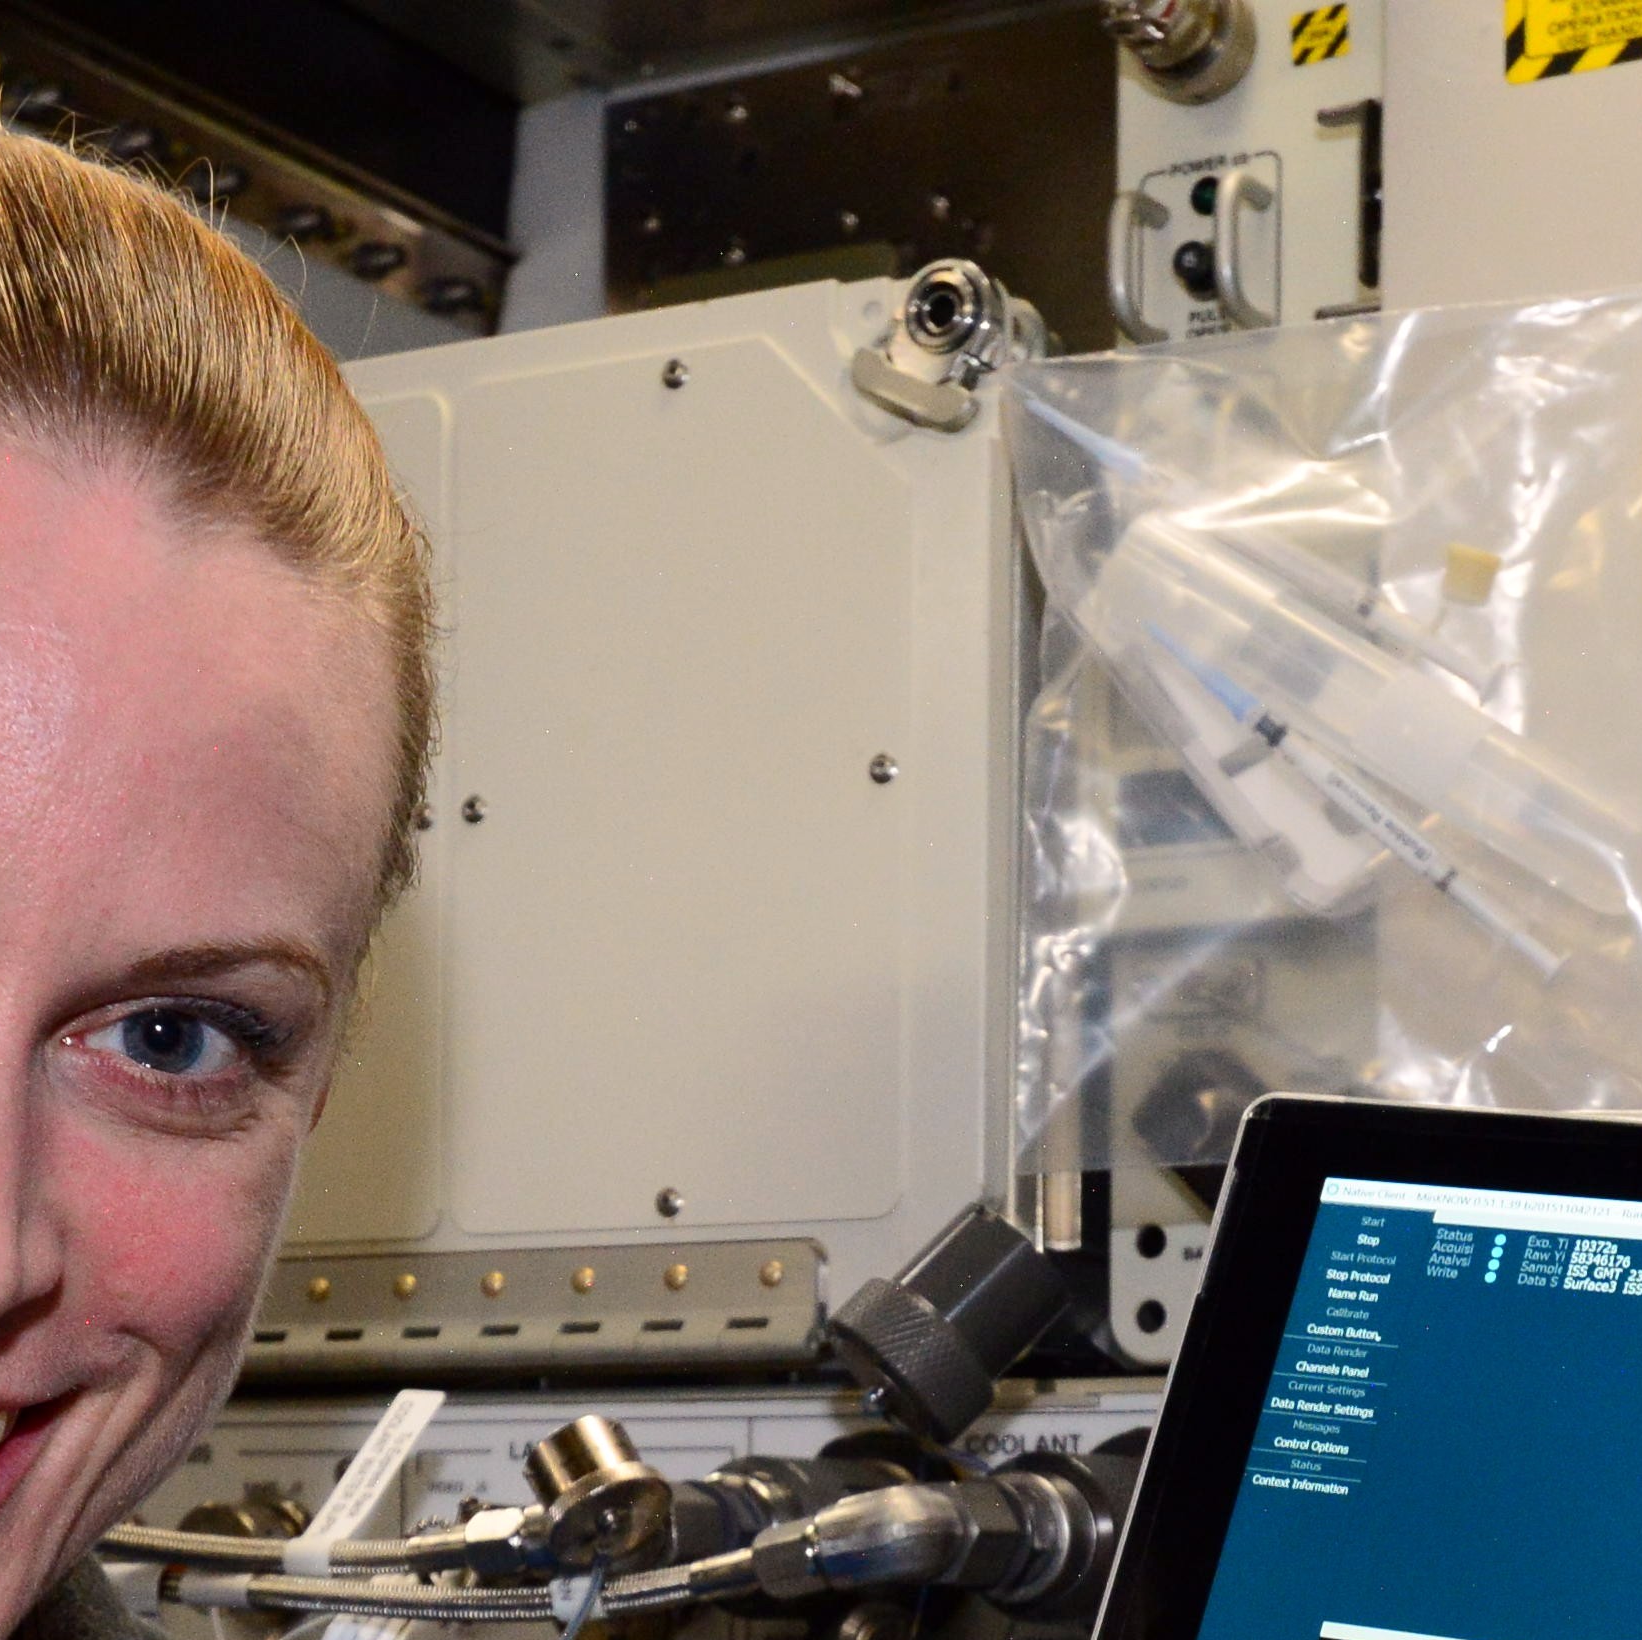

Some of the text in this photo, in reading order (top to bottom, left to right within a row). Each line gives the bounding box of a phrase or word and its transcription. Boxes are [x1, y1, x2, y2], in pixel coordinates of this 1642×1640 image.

[1357, 1233, 1380, 1248] Stop
[1325, 1268, 1391, 1285] Stop Protocol
[1566, 1263, 1590, 1280] ISS
[1593, 1265, 1624, 1281] GMT
[1327, 1287, 1379, 1303] Name Run
[1295, 1360, 1370, 1379] Channels Panel
[1270, 1396, 1374, 1420] Data Render Settings
[965, 1433, 1081, 1454] COOLANT
[1273, 1436, 1350, 1456] Control Options
[1252, 1473, 1349, 1496] Context Information
